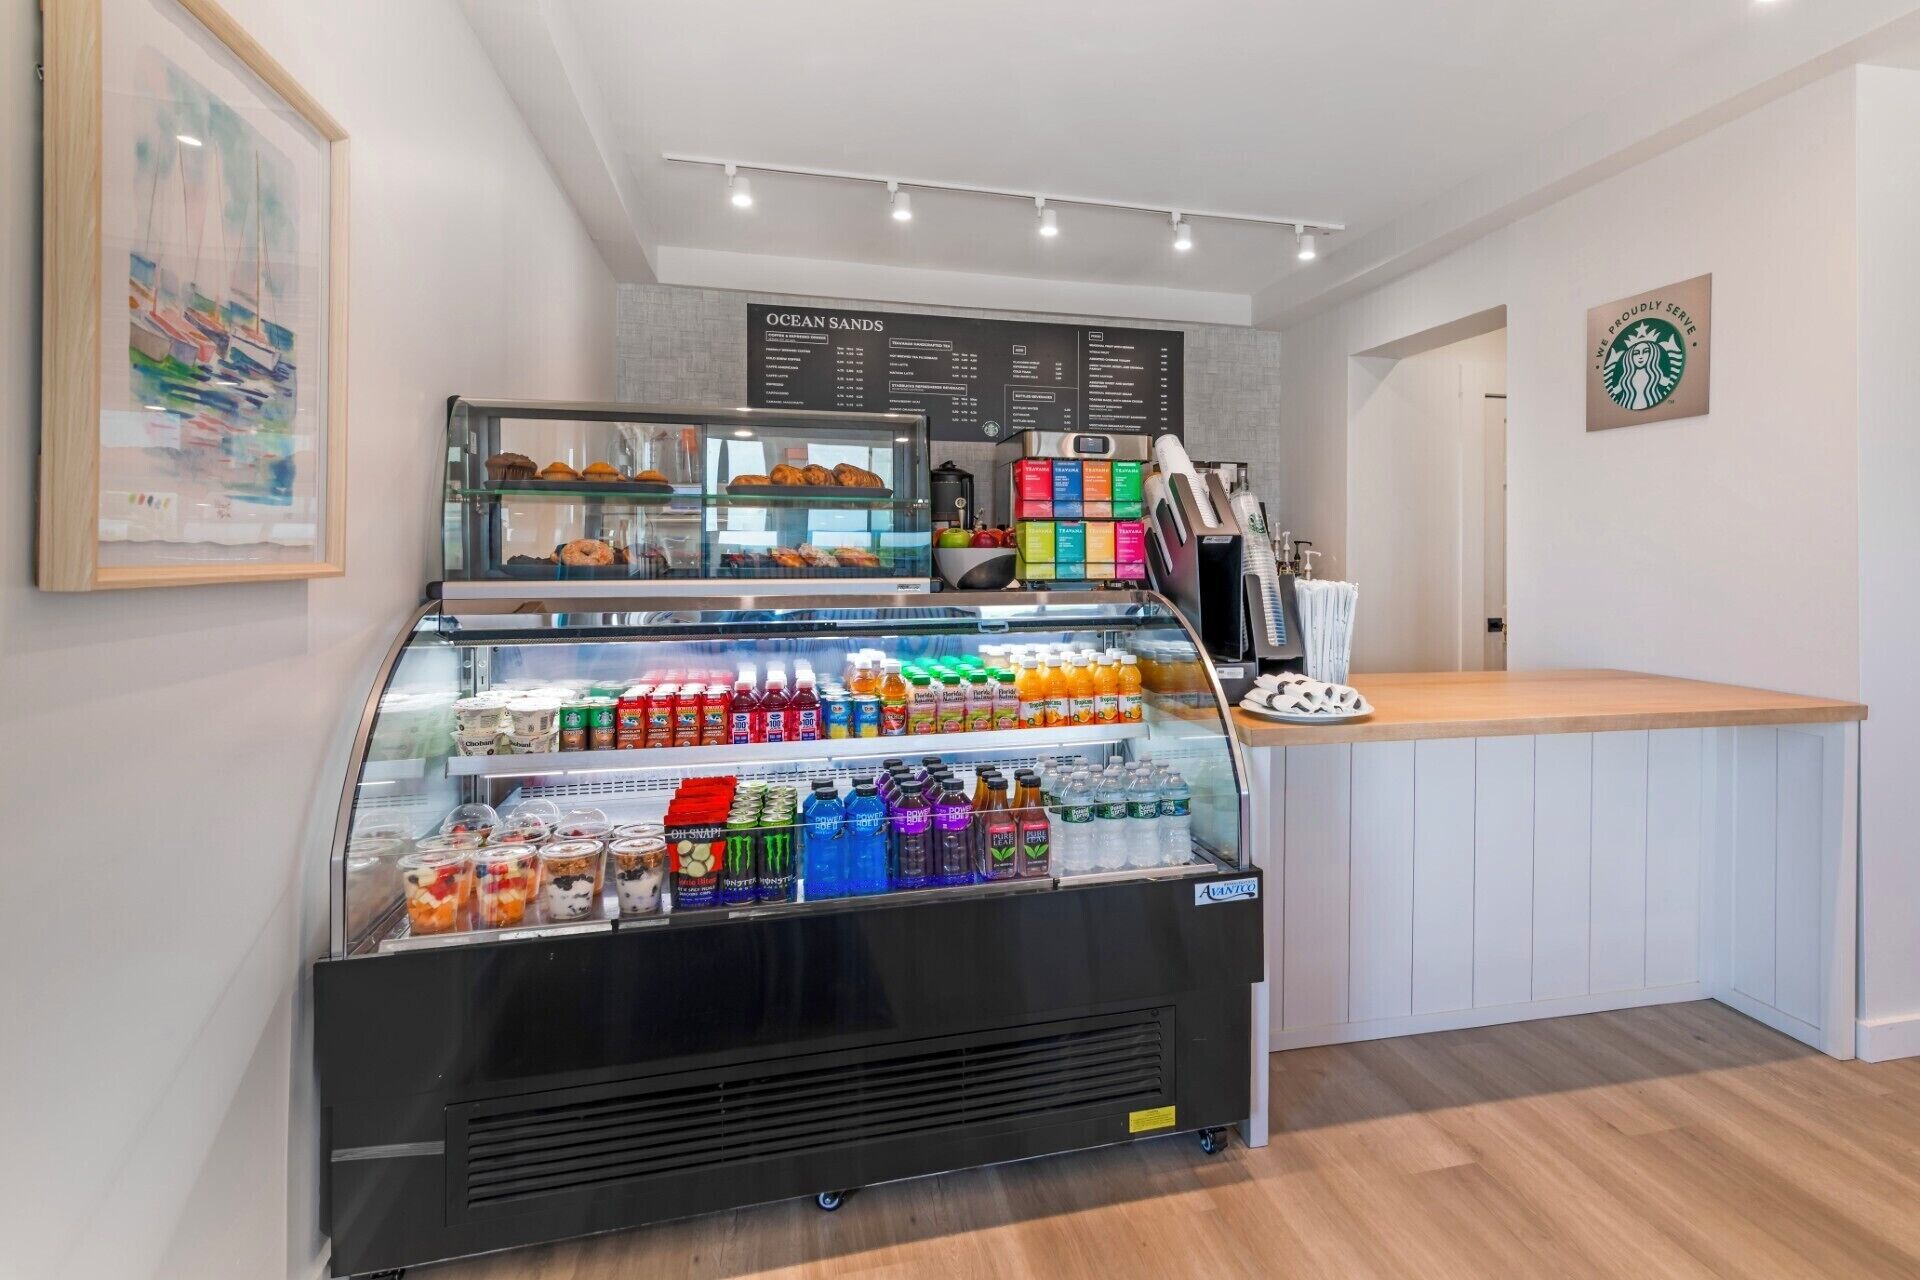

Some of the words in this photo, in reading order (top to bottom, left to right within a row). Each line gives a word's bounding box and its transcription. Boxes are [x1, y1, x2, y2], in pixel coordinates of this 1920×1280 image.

[766, 313, 826, 328] OCEAN
[829, 317, 884, 332] SANDS
[1596, 338, 1609, 358] WE
[1608, 300, 1662, 334] PROUDLY
[1665, 303, 1697, 335] SERVE
[856, 811, 884, 821] POWER
[906, 807, 931, 816] POWER
[815, 815, 843, 824] POWER
[671, 828, 688, 839] OH
[688, 827, 721, 839] SNAP!
[993, 832, 1014, 840] PURE
[1199, 884, 1256, 900] AVANTCO
